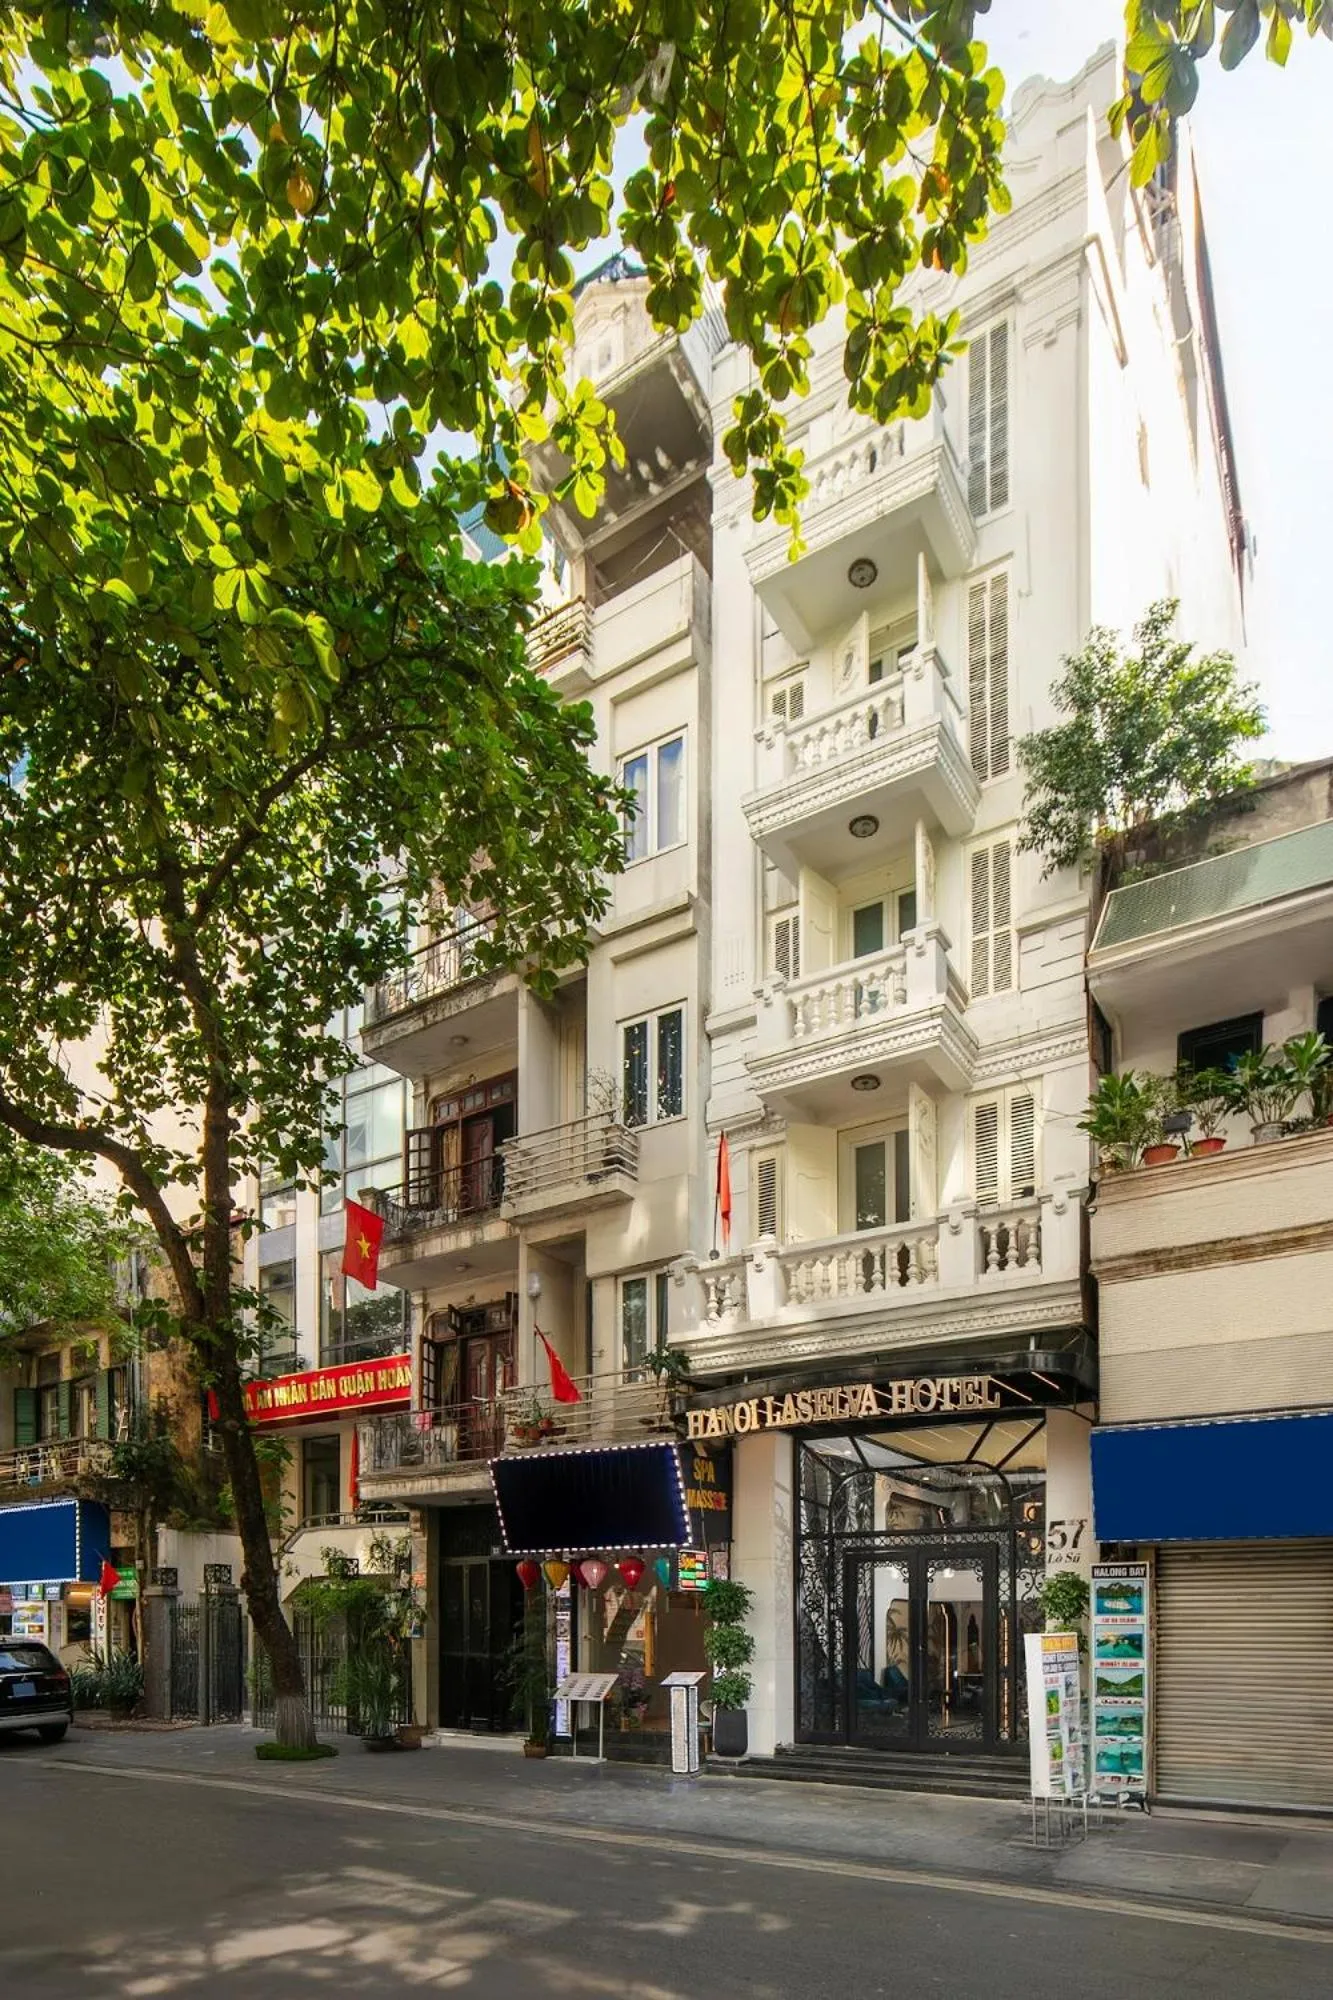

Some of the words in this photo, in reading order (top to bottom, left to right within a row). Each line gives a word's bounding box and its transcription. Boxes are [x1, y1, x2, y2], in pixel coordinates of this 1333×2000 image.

[273, 1380, 307, 1408] NHÂN
[339, 1369, 374, 1398] QUẬN
[687, 1398, 759, 1440] HANOI
[765, 1383, 879, 1427] LASELVA
[888, 1375, 1001, 1416] HOTEL
[693, 1457, 715, 1482] SPA
[1047, 1519, 1088, 1550] 57
[1093, 1566, 1127, 1577] HALONG
[1129, 1566, 1145, 1577] BAY
